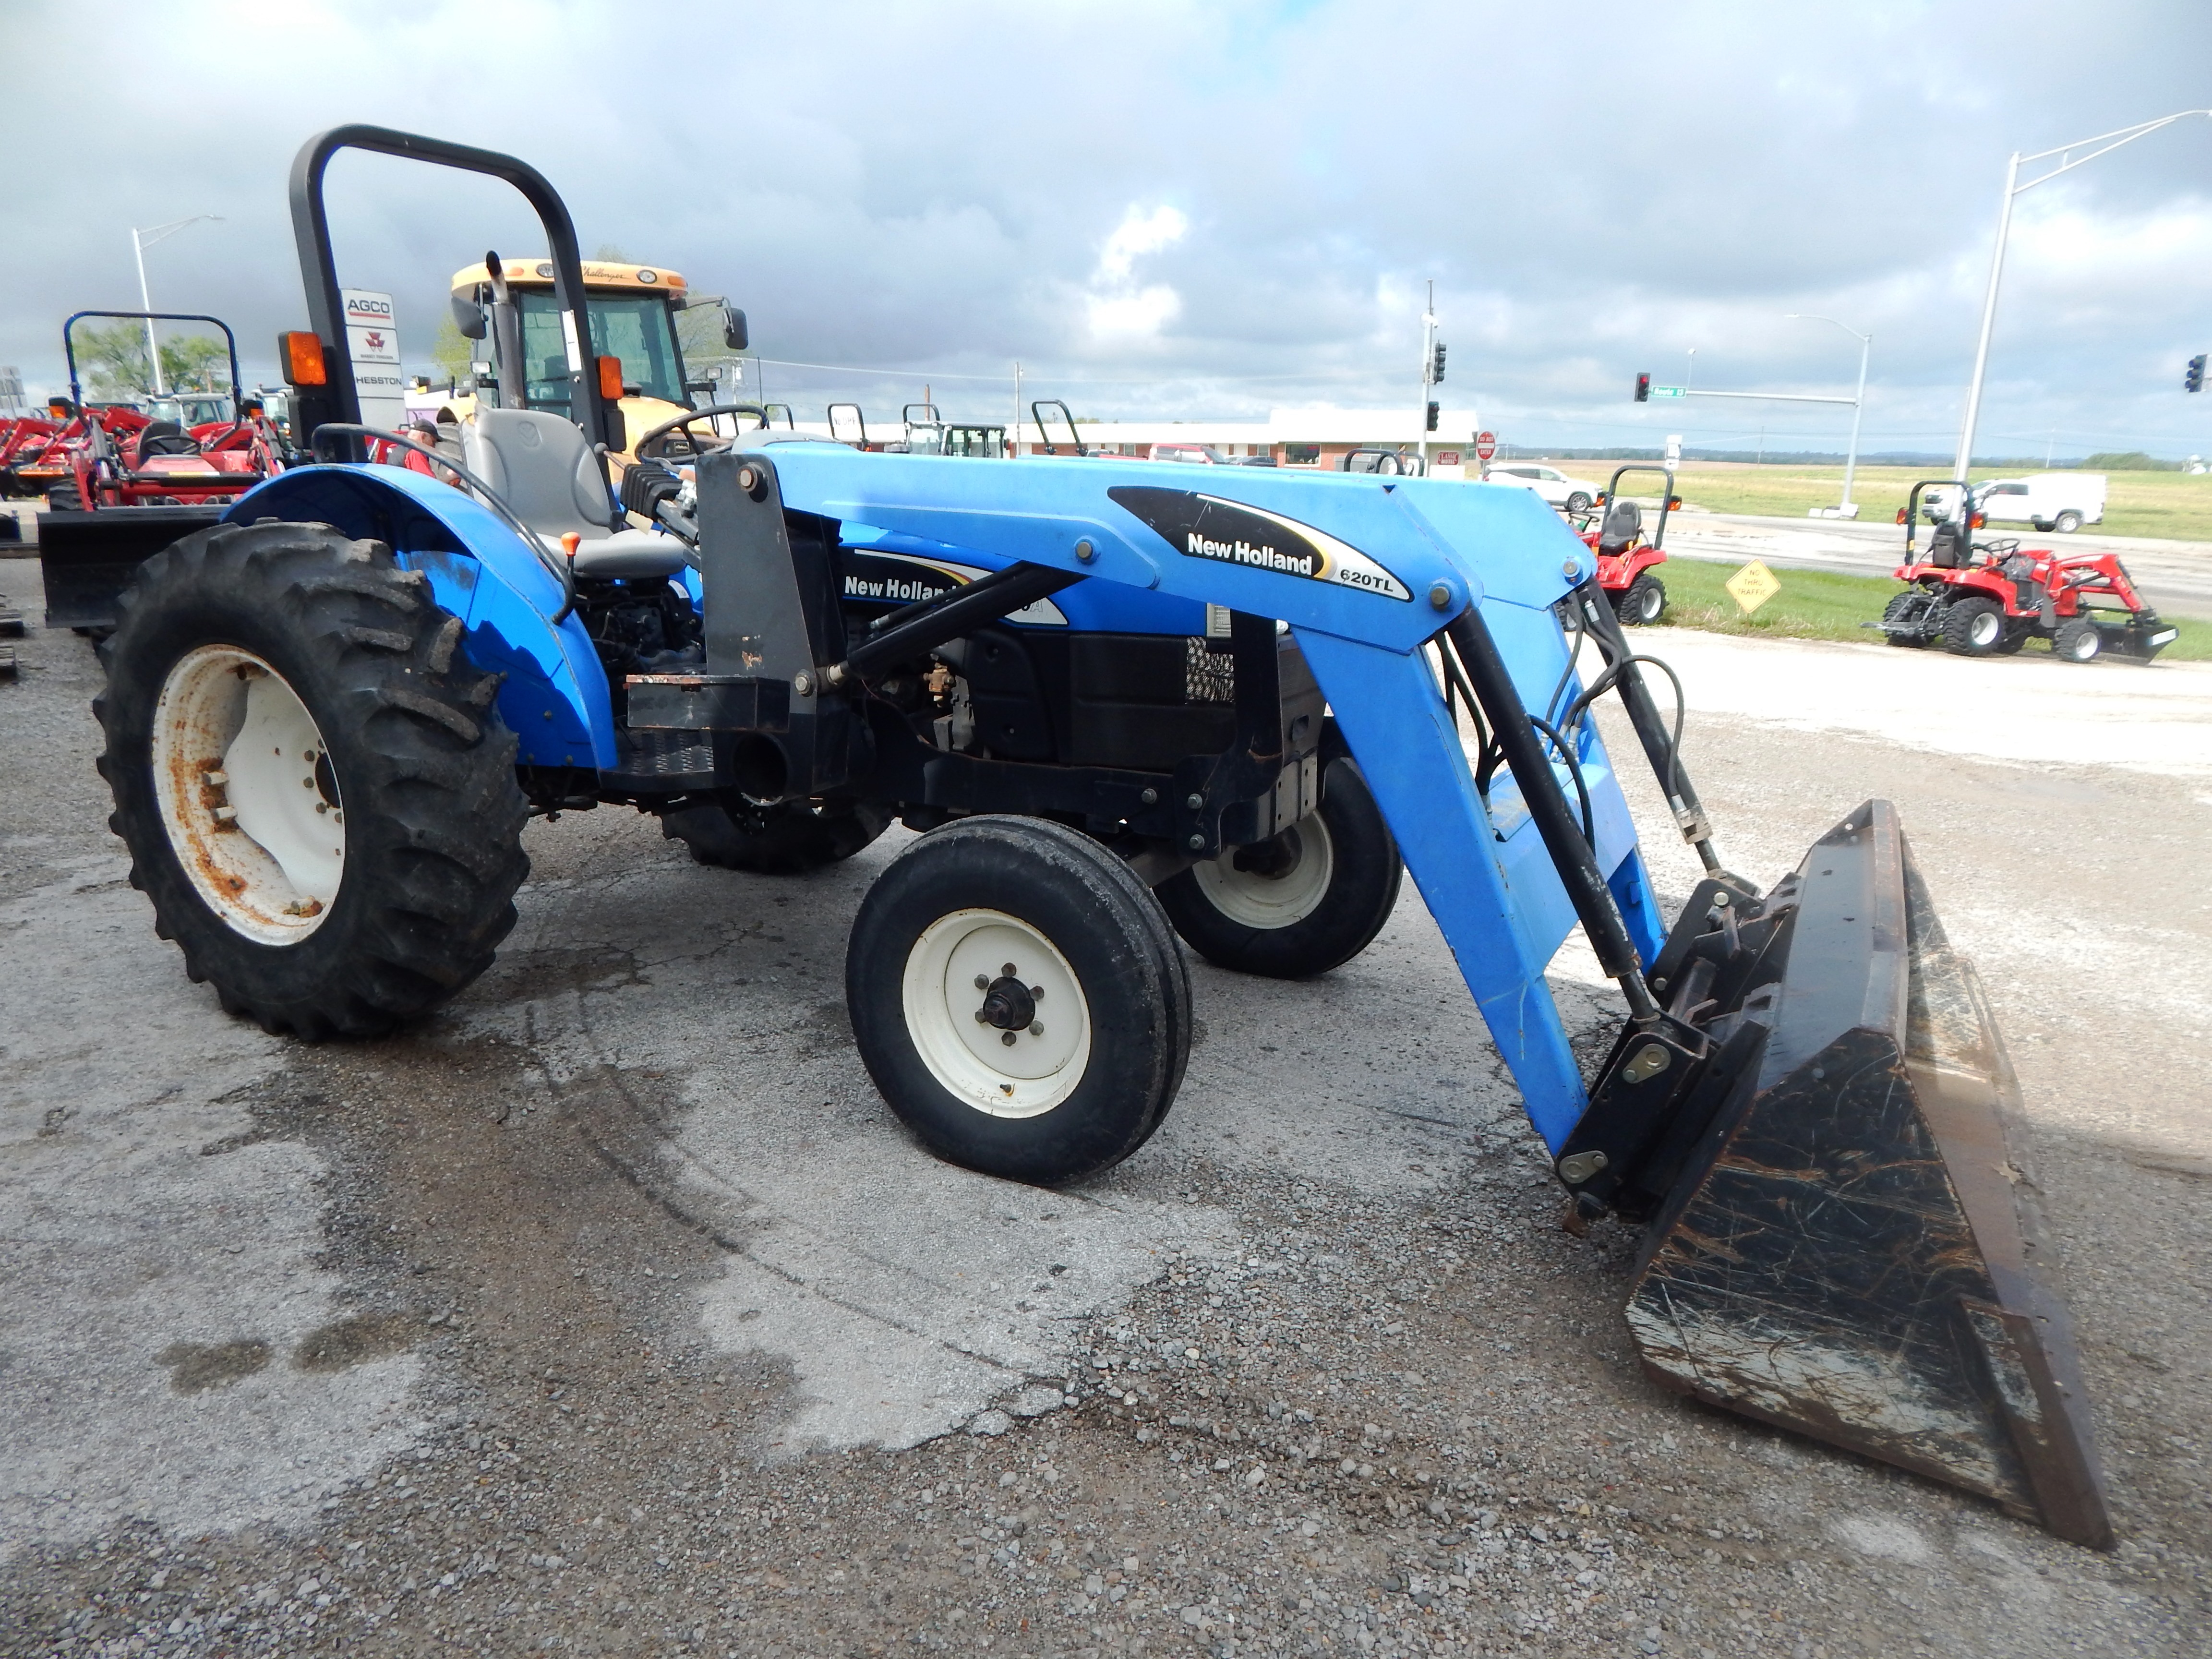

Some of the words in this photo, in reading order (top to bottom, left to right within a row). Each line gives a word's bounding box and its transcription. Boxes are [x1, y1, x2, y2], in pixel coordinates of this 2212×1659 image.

[348, 299, 390, 313] AGCO
[356, 376, 402, 385] HESSTON
[1188, 533, 1232, 559] New
[1235, 541, 1312, 576] Holland
[845, 576, 882, 596] New
[886, 578, 957, 601] Hollan
[1340, 569, 1394, 592] 620TL
